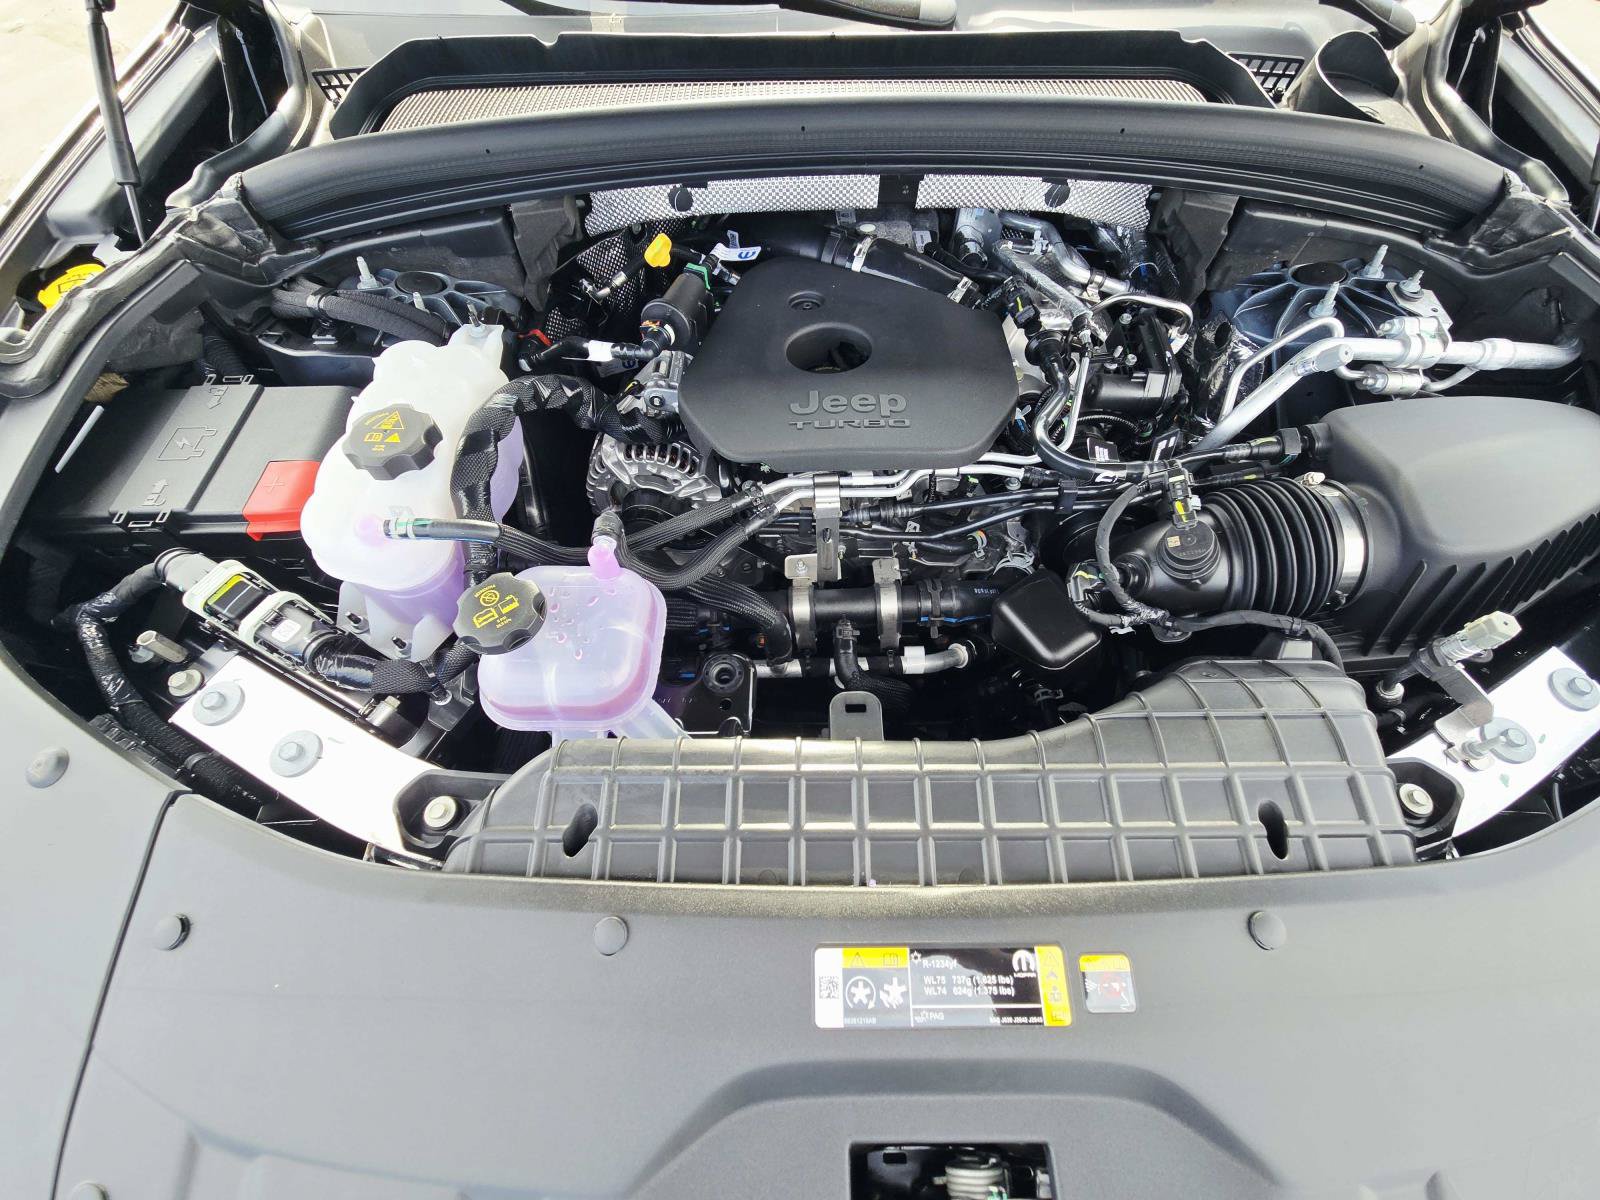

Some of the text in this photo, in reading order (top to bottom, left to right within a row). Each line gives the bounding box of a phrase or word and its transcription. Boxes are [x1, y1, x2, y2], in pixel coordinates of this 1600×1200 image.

[789, 389, 908, 418] Jeep
[787, 419, 912, 430] TURBO
[922, 958, 958, 969] R-1234yf
[923, 975, 946, 985] WL75
[952, 975, 972, 987] 737g
[924, 986, 948, 996] WL74
[974, 985, 998, 997] (1.375
